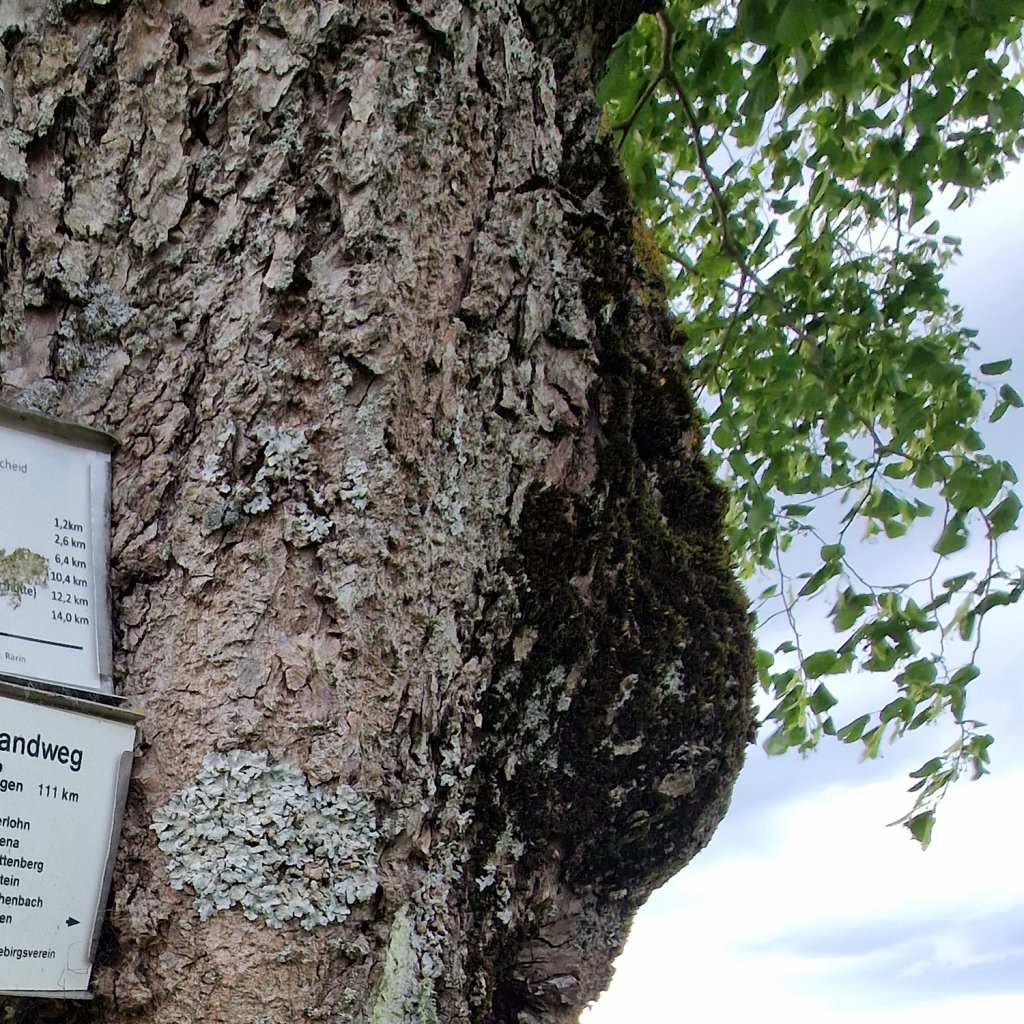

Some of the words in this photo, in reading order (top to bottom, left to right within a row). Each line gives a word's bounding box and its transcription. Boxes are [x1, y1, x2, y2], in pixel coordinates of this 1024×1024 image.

[54, 535, 69, 547] 2,6
[71, 536, 86, 549] km
[55, 554, 69, 566] 6,4
[72, 555, 86, 569] km
[51, 572, 70, 584] 10,4
[73, 573, 88, 588] km
[52, 591, 71, 603] 12,2
[74, 592, 89, 606] km
[52, 610, 72, 623] 14,0
[75, 611, 89, 625] km
[38, 784, 57, 799] 111
[62, 788, 79, 803] km
